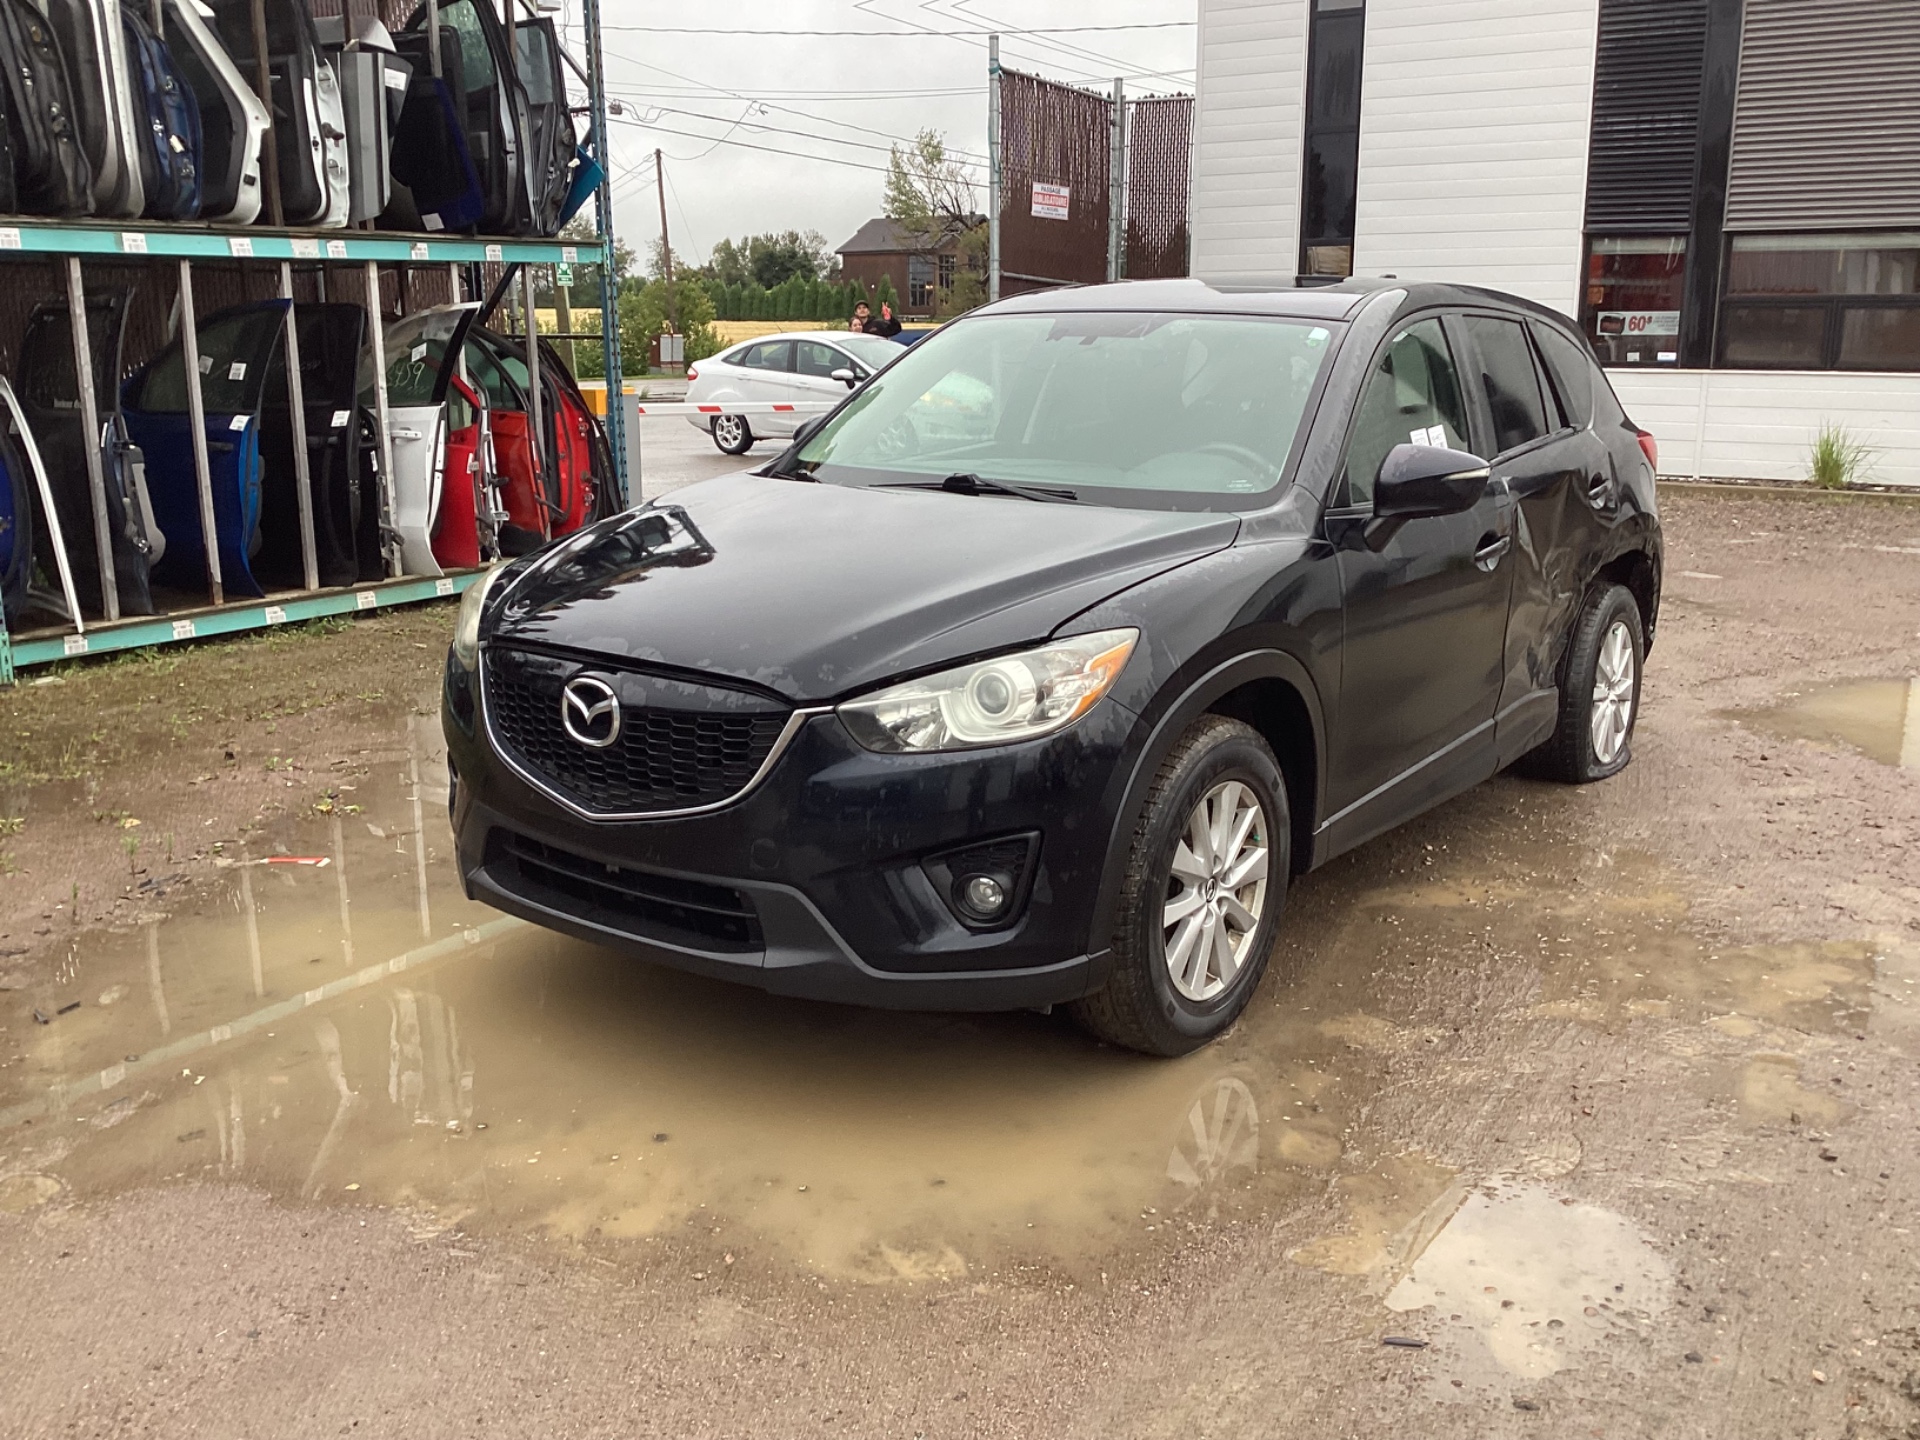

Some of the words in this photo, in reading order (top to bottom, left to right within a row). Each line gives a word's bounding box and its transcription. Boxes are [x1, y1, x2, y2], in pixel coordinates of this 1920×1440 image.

[1041, 185, 1061, 194] PASSAGE
[1034, 193, 1067, 207] OBLIGATOIRE
[1628, 316, 1652, 332] 60$
